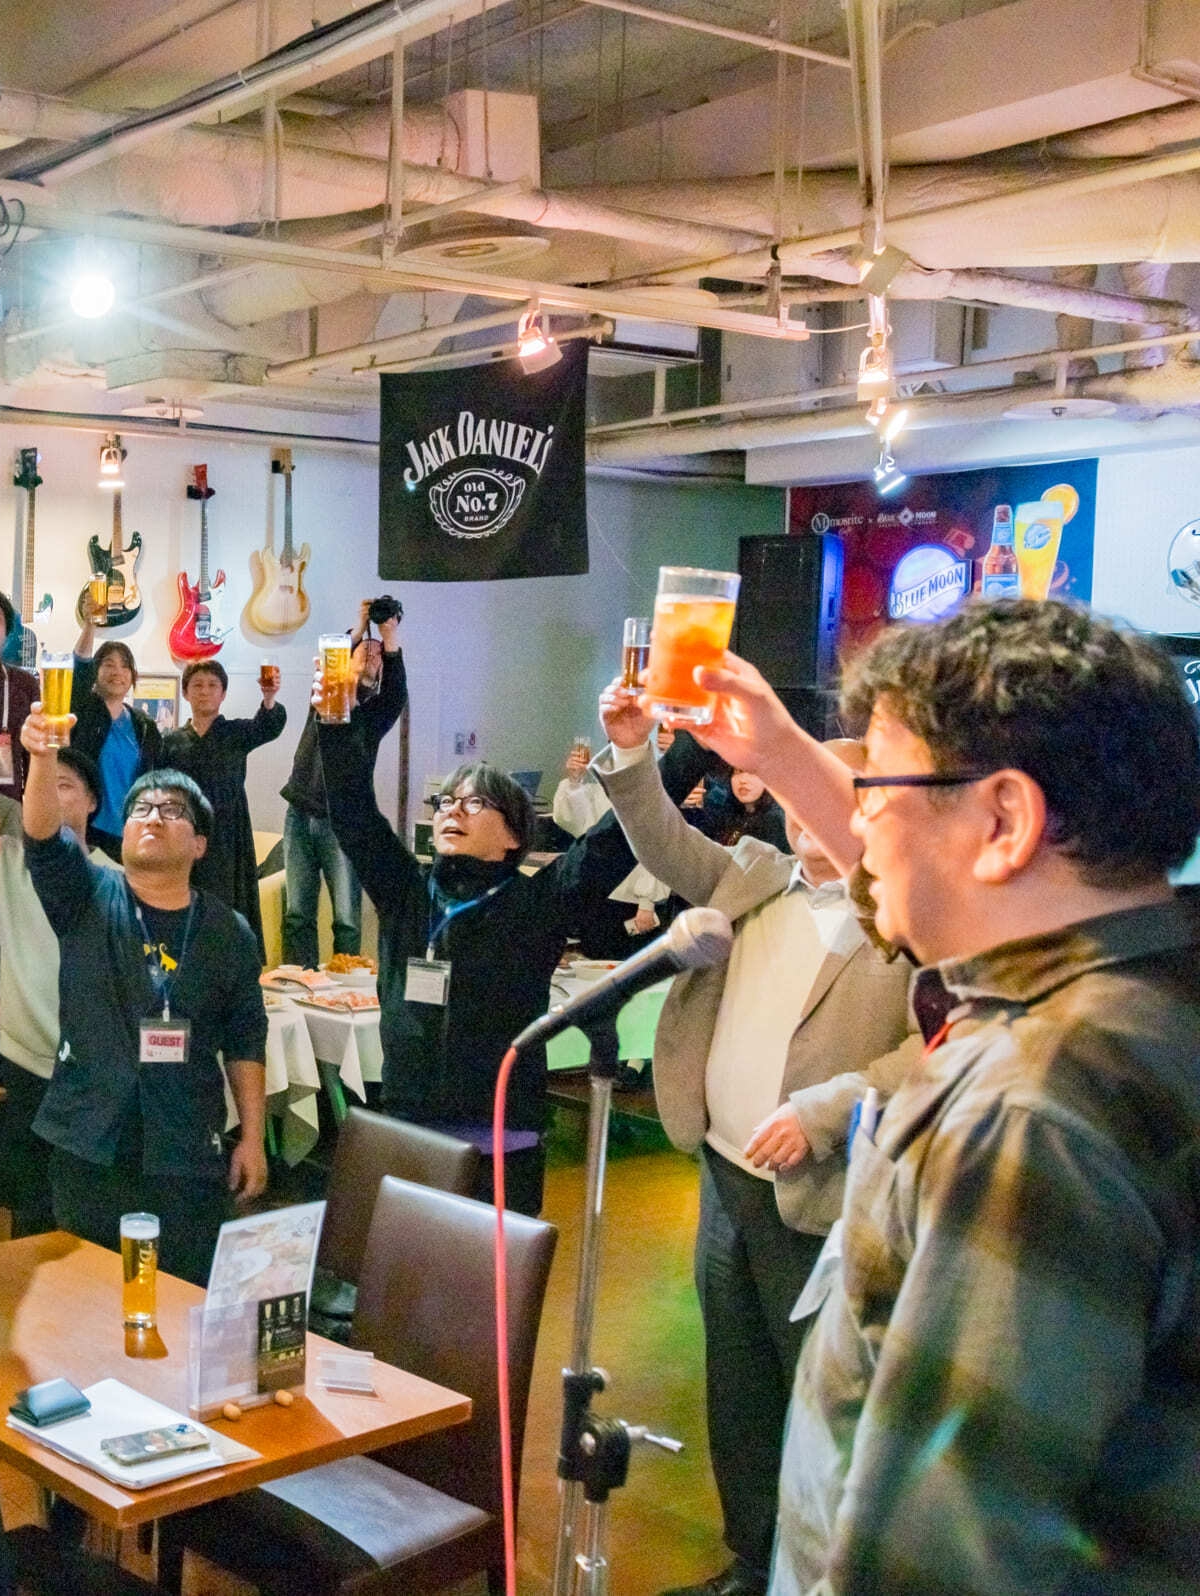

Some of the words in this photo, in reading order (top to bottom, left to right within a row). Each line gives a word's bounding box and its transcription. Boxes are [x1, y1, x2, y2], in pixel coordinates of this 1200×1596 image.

[403, 425, 458, 484] JACK
[464, 481, 485, 493] Old
[454, 492, 498, 513] No.7
[928, 567, 963, 597] MOON
[148, 1034, 182, 1048] GUEST
